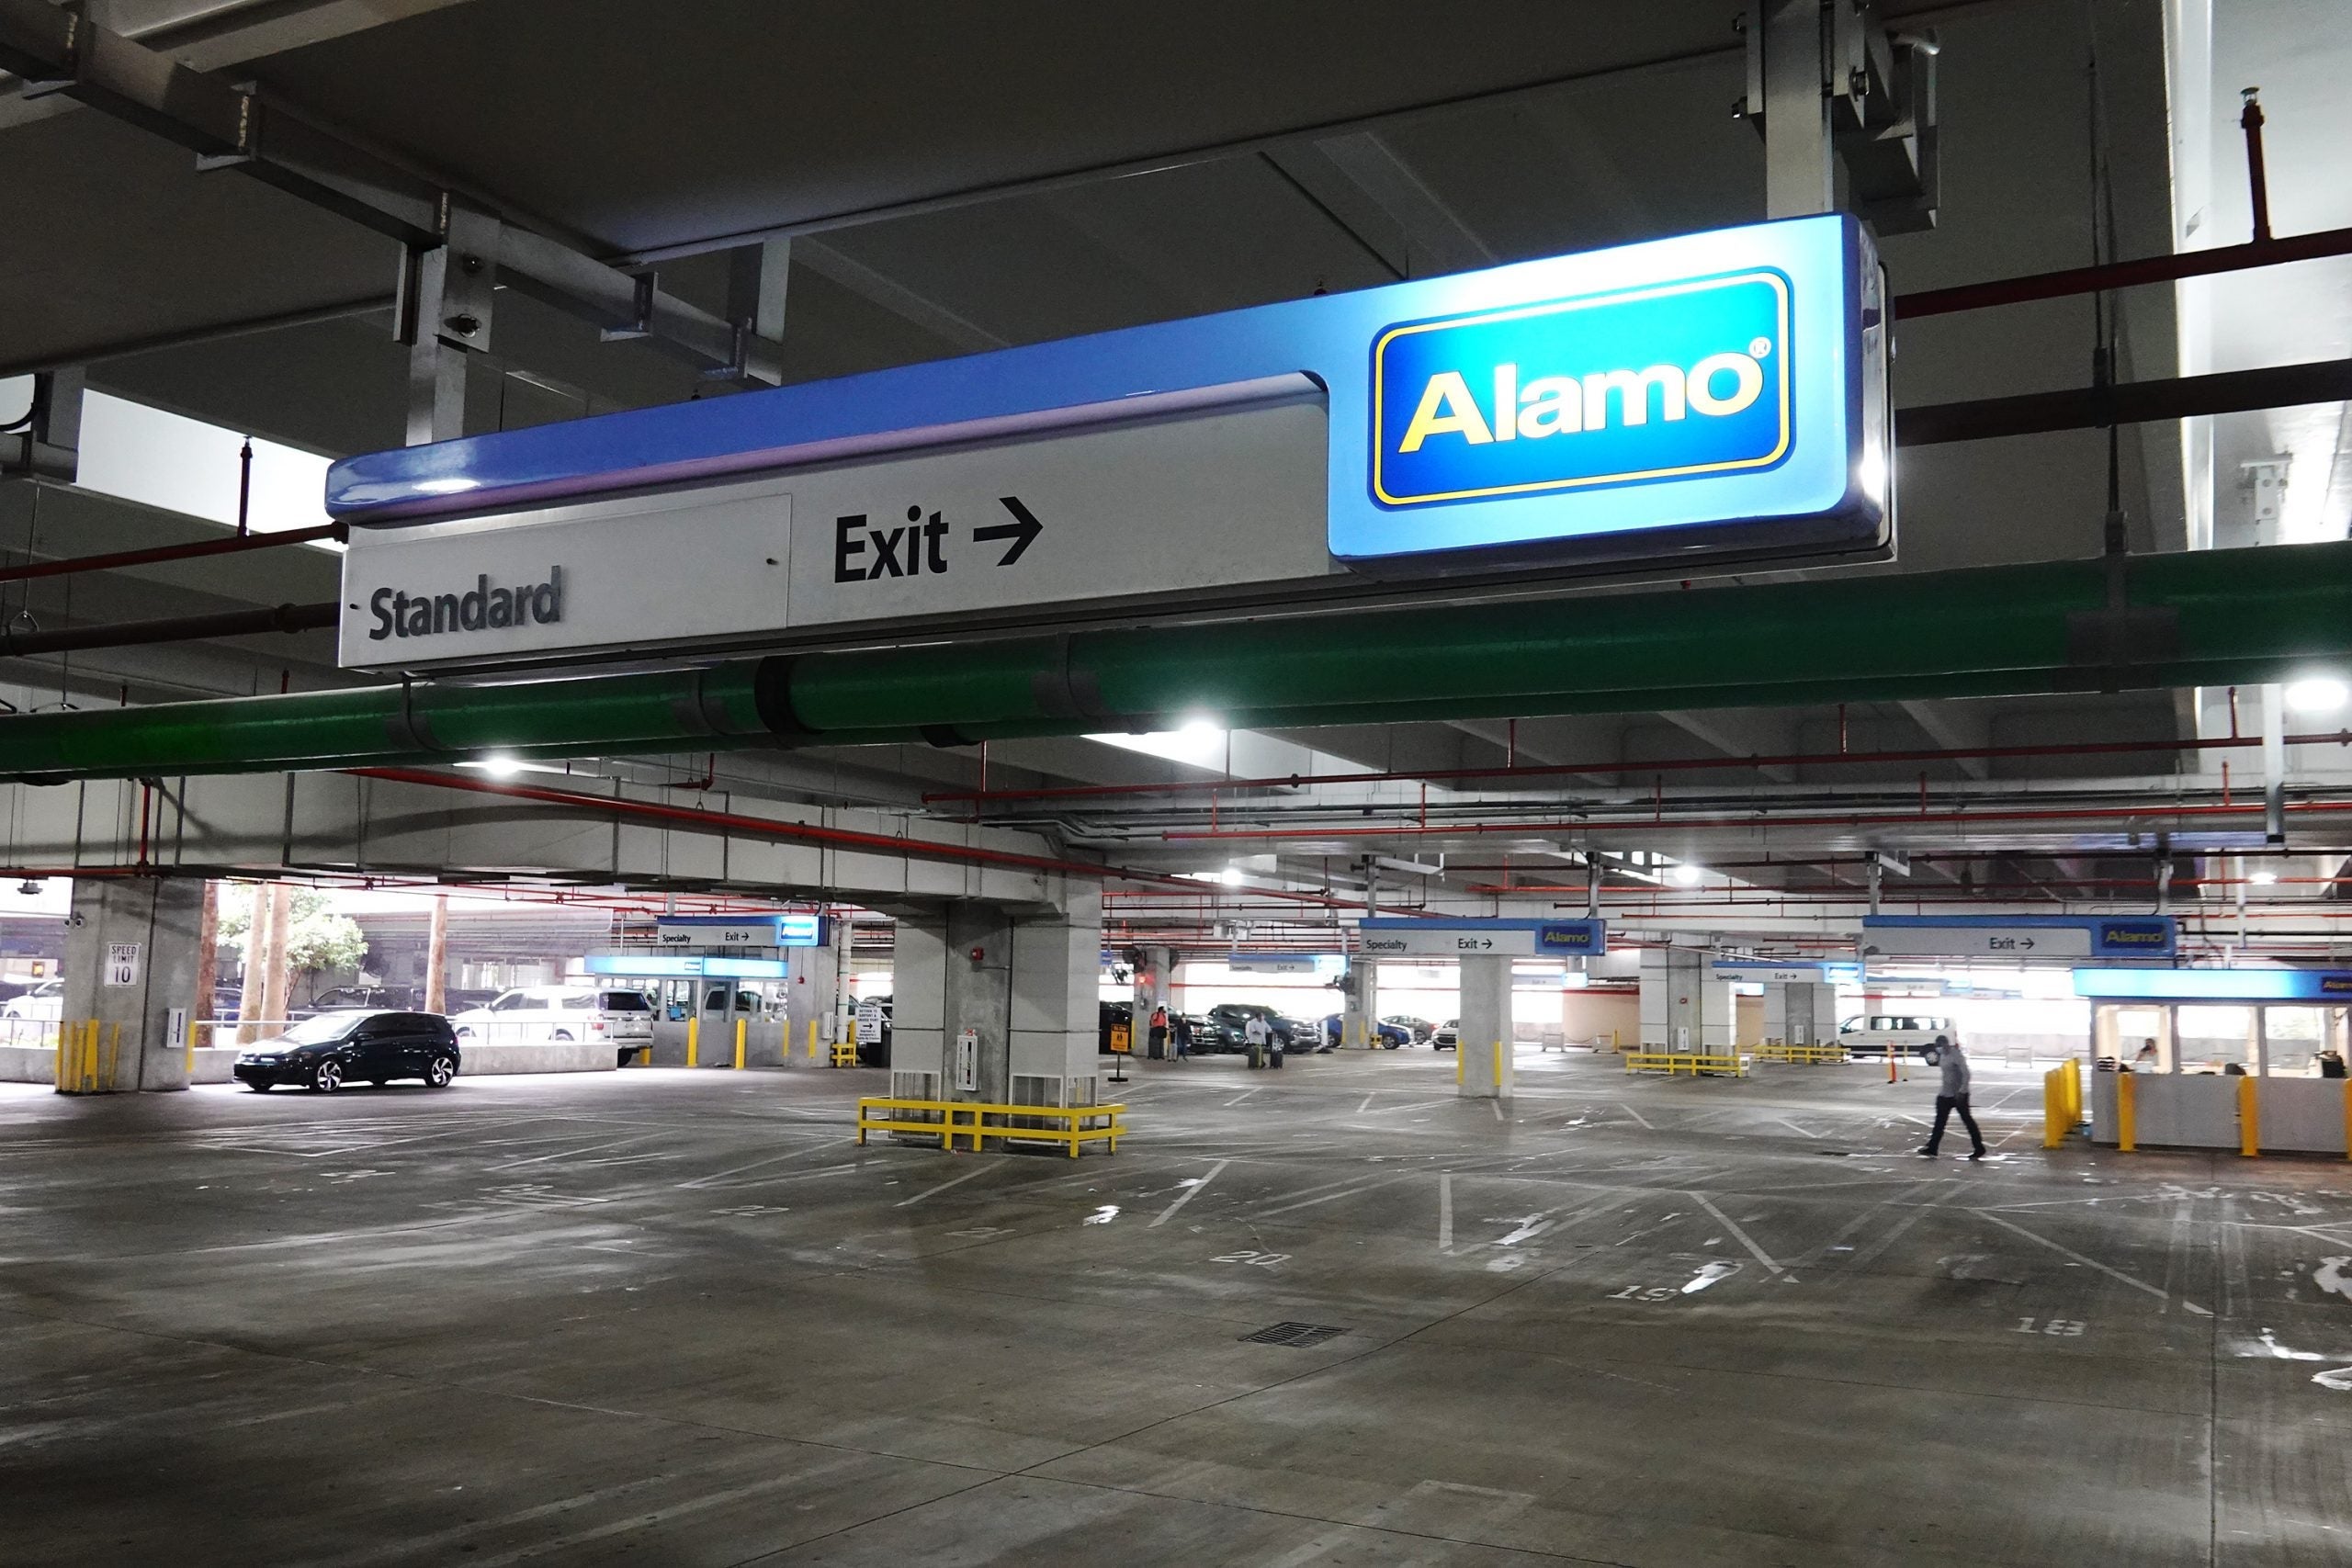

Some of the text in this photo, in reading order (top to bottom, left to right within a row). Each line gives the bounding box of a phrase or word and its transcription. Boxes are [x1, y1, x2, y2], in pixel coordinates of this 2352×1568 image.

[1398, 350, 1764, 454] Alamo
[833, 504, 949, 583] Exit
[368, 564, 561, 641] Standard
[662, 934, 691, 943] Specialty
[725, 931, 740, 942] Exit
[1544, 931, 1590, 943] Alamo
[2105, 930, 2164, 943] Alamo
[111, 945, 137, 955] SPEED
[1366, 940, 1408, 952] Specialty
[1458, 938, 1478, 950] Exit
[1989, 937, 2016, 950] Exit
[115, 965, 131, 983] 10
[1774, 972, 1788, 980] Exit
[1208, 1250, 1293, 1266] 20
[2009, 1316, 2087, 1337] 18
